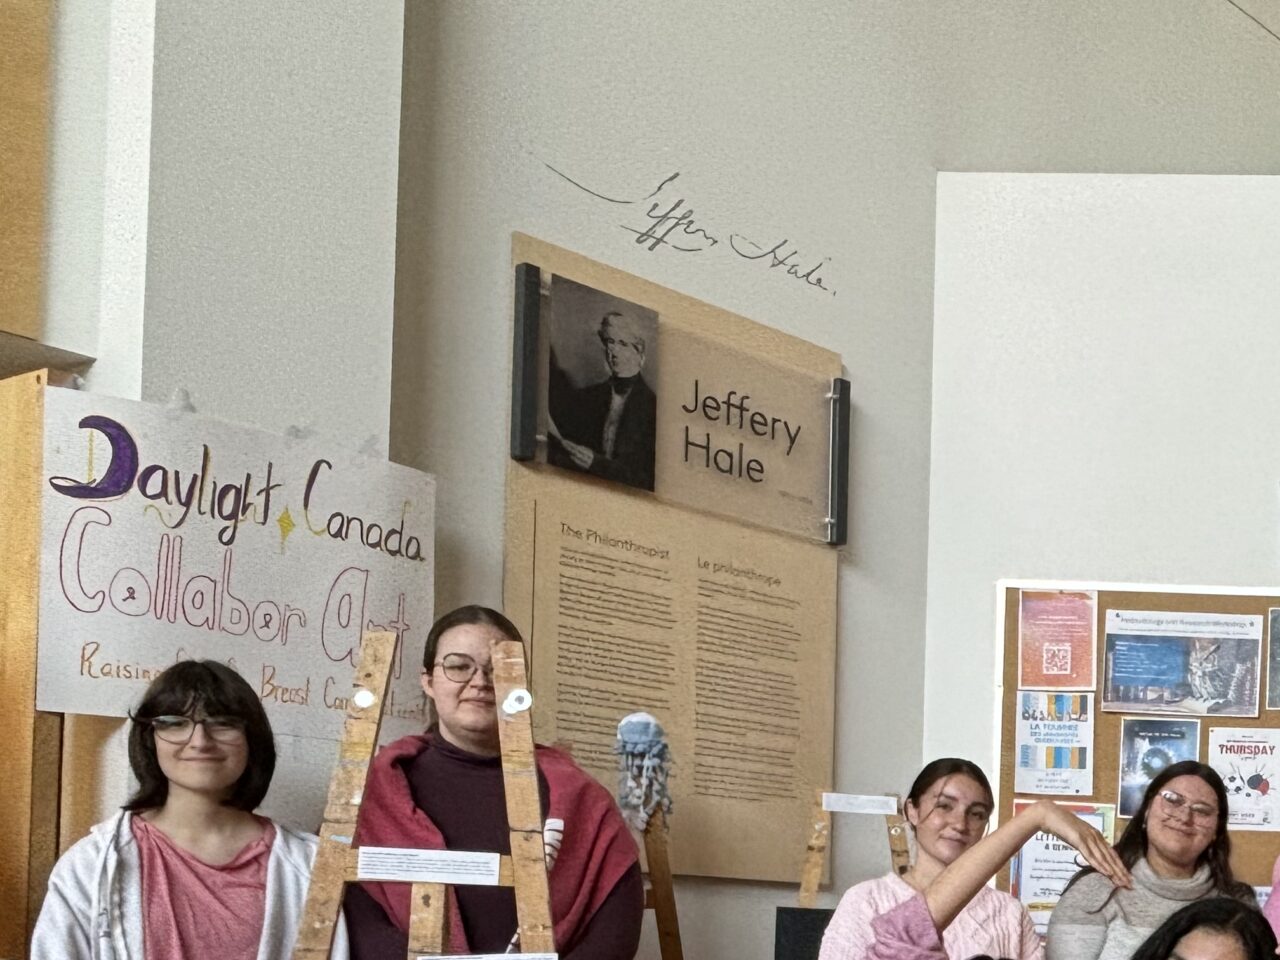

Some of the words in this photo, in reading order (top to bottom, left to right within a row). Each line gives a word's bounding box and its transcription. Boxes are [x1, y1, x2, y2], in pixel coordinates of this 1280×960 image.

[681, 379, 802, 456] Jeffery
[683, 425, 765, 483] Hale
[48, 414, 283, 547] Daylight
[303, 458, 426, 562] Canada
[560, 521, 583, 541] The
[59, 506, 307, 646] Collabor
[1218, 743, 1276, 756] THURSDAY
